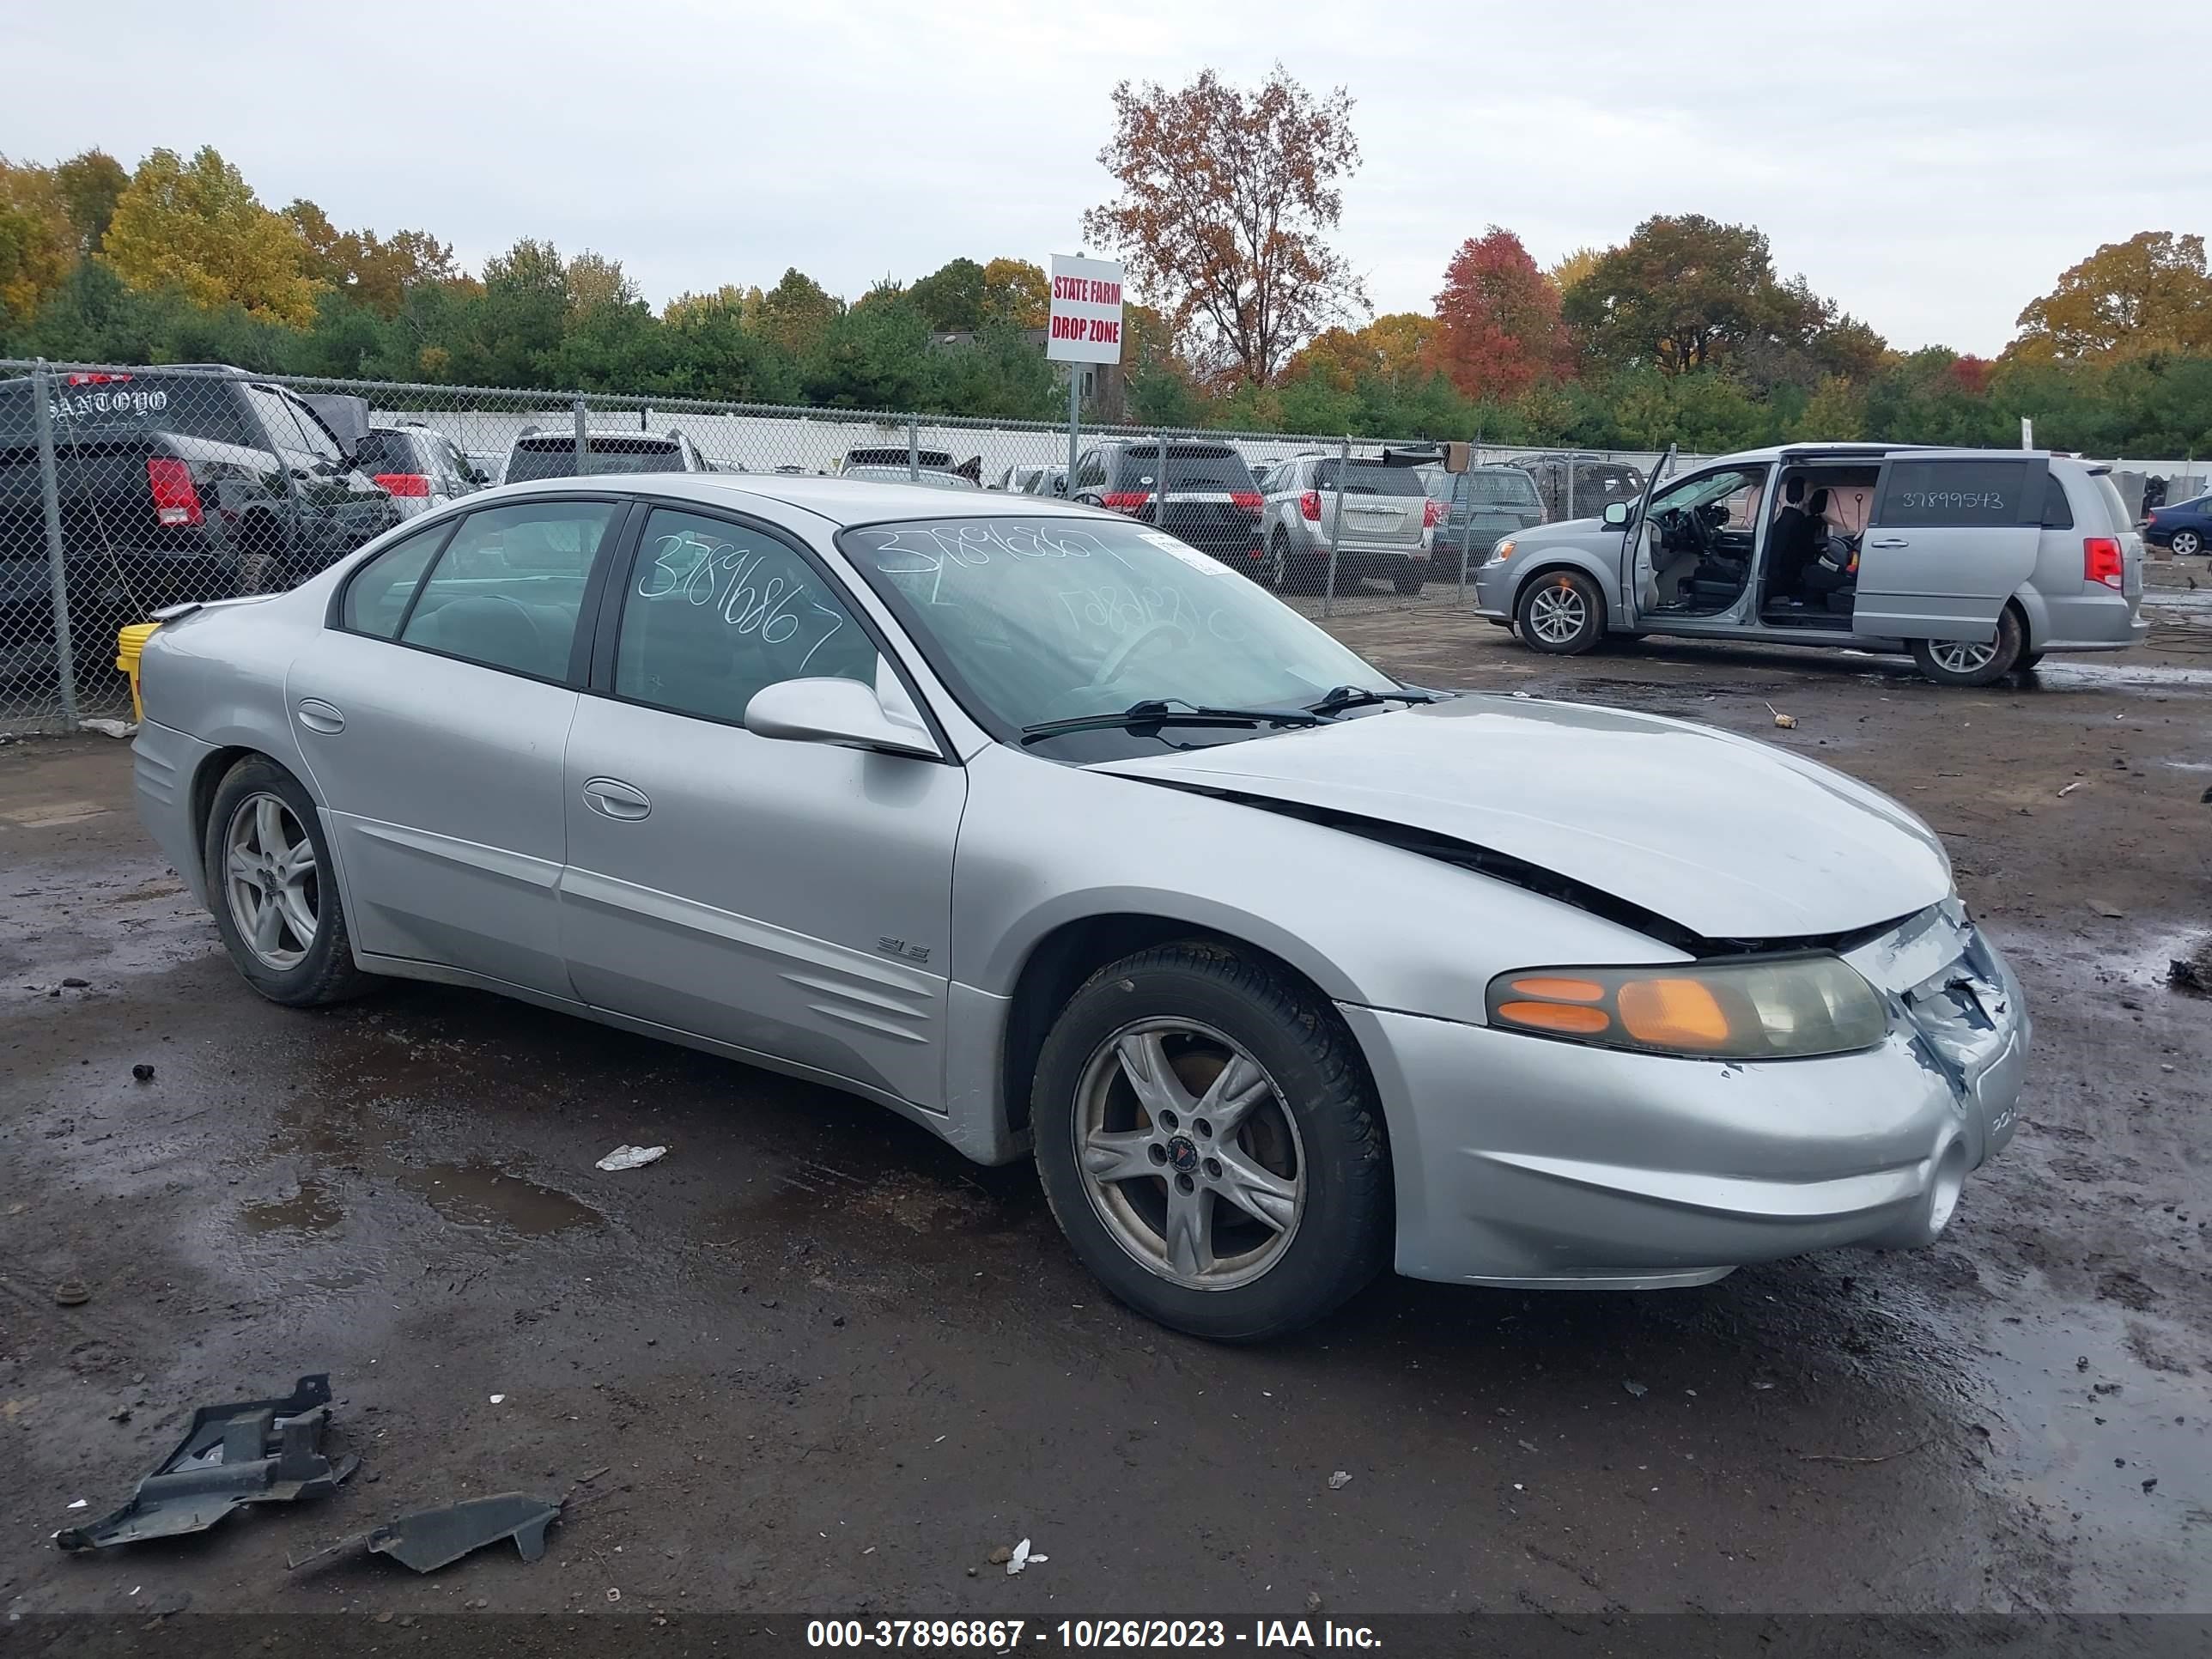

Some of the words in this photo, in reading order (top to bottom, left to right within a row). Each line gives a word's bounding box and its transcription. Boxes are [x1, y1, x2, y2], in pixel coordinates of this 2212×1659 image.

[1054, 276, 1088, 302] STATE
[1091, 280, 1121, 306] FARM
[1052, 315, 1087, 341] DROP
[1089, 319, 1120, 344] ZONE
[1902, 491, 2005, 509] 37899543
[857, 523, 1135, 574] 37896867
[638, 535, 843, 674] 37896867
